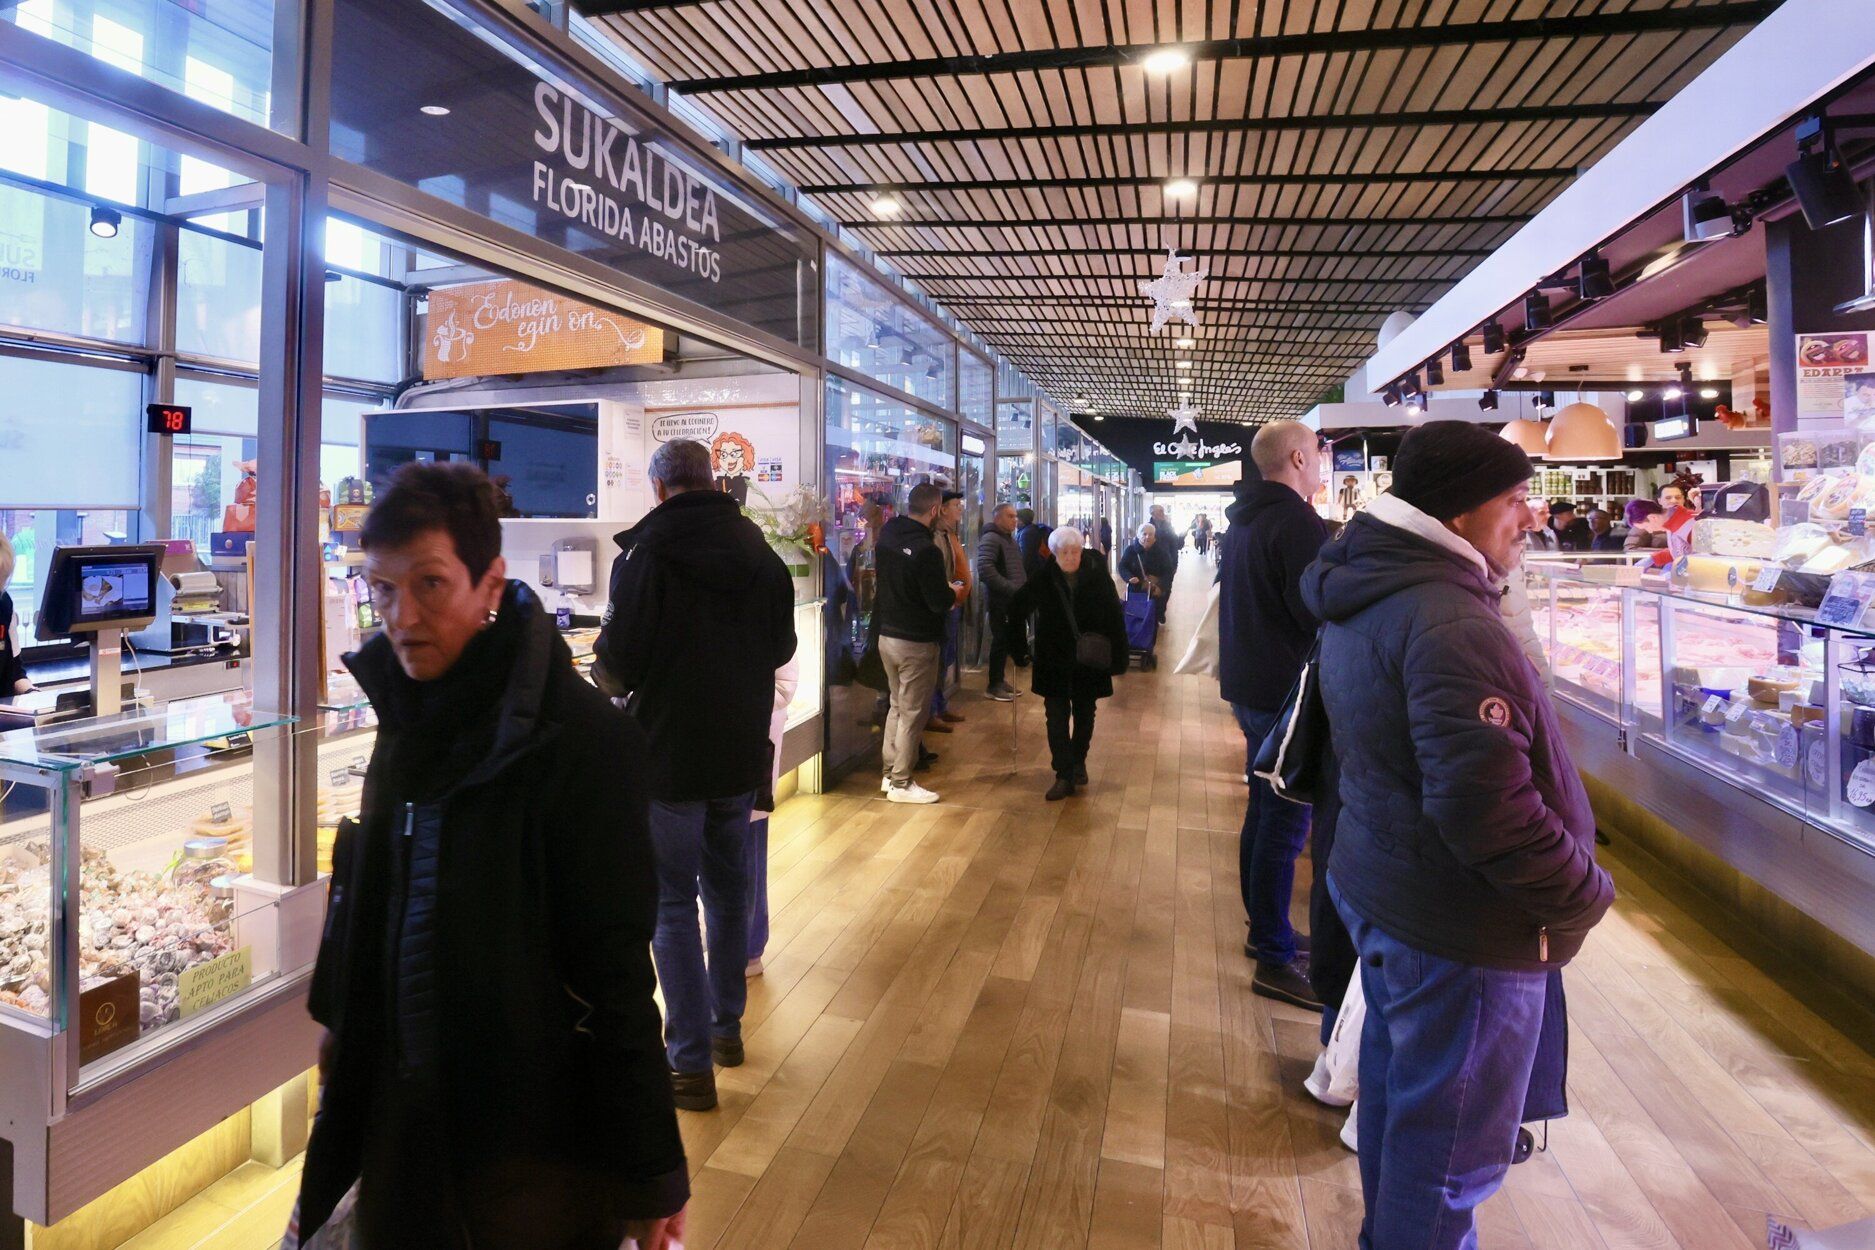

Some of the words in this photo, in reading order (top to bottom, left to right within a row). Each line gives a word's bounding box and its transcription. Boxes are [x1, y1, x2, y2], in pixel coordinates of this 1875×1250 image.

[533, 81, 721, 242] SUKALDEA
[533, 160, 635, 245] FLORIDA
[639, 217, 721, 284] ABASTOS
[502, 314, 563, 352] egin
[569, 311, 598, 331] on
[163, 410, 184, 430] 78
[1153, 441, 1167, 455] El
[189, 979, 214, 998] APTO
[218, 964, 245, 985] PARA
[192, 952, 241, 983] PRODUCTO
